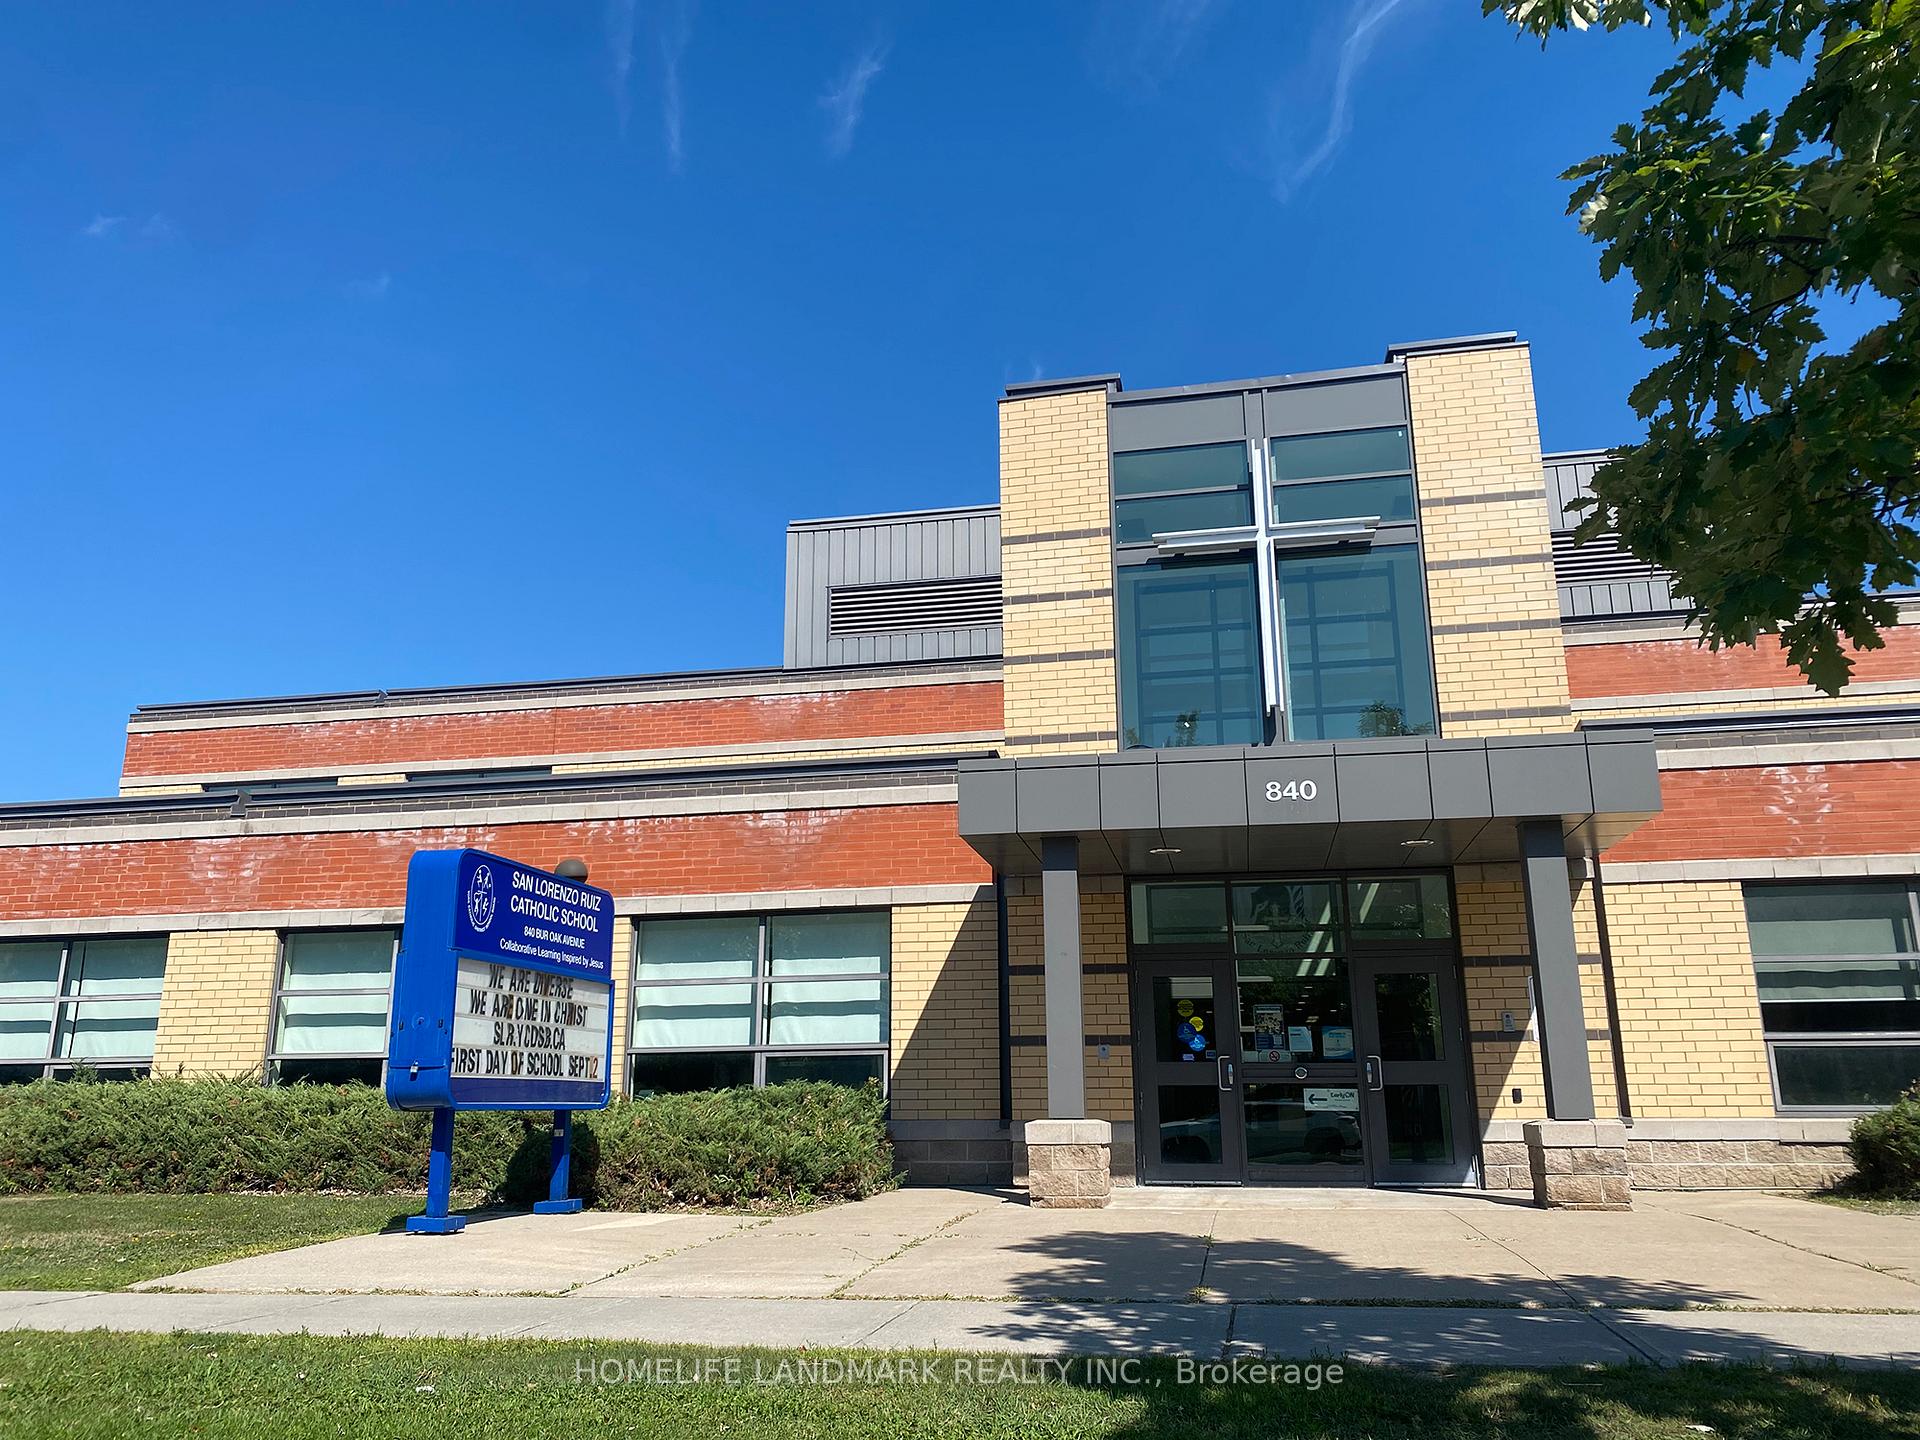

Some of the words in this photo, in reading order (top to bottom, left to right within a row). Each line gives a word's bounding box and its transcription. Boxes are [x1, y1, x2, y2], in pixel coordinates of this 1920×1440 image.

[1265, 780, 1317, 801] 840
[512, 871, 533, 893] SAN
[535, 880, 579, 906] LORENZO
[580, 891, 602, 911] RUIZ
[510, 895, 560, 922] CATHOLIC
[561, 908, 599, 932] SCHOOL
[524, 925, 535, 937] 840
[536, 927, 549, 941] BUR
[549, 931, 562, 944] OAK
[562, 934, 585, 949] AVENUE
[500, 938, 537, 956] Collaborative
[537, 945, 561, 963] Learning
[561, 951, 582, 965] Inspired
[582, 954, 589, 969] by
[589, 956, 604, 969] Jesus
[488, 964, 505, 989] WE
[508, 969, 531, 993] ARE
[533, 973, 574, 999] DIVERSE
[470, 989, 487, 1015] WE
[491, 994, 514, 1019] ARE
[515, 997, 539, 1021] ONE
[540, 1000, 550, 1022] IN
[554, 1001, 588, 1027] CHRIST
[493, 1021, 566, 1050] SLR.YCDSB.CA
[485, 1049, 508, 1075] DAY
[511, 1050, 524, 1075] OF
[526, 1052, 564, 1077] SCHOOL
